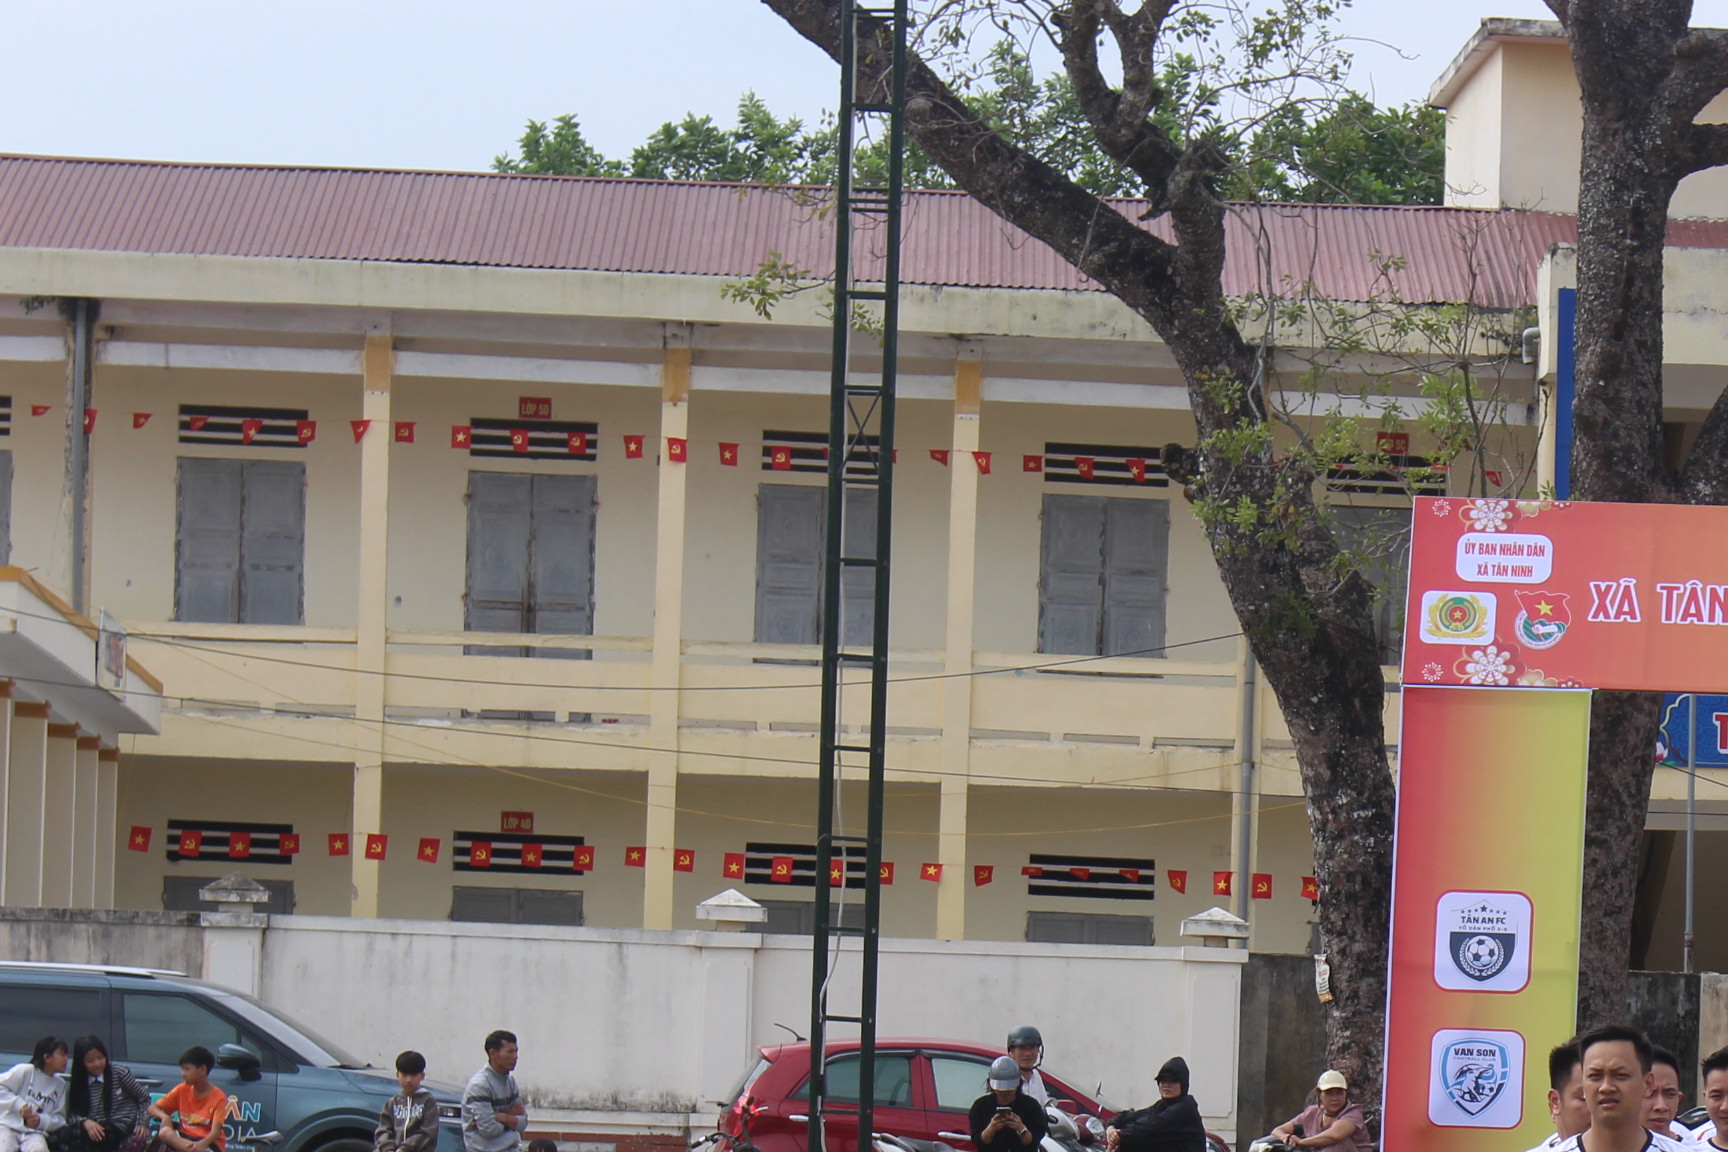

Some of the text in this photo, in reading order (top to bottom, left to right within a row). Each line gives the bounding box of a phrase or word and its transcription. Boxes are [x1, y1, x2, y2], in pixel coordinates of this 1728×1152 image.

[1464, 538, 1546, 557] ỦY BAN NHÂN DÂN
[1477, 562, 1533, 578] XÃ TÂN NINH
[1587, 578, 1642, 624] XÃ
[1481, 916, 1494, 924] AN
[1496, 916, 1506, 925] FC
[1454, 1048, 1496, 1057] VAN SON
